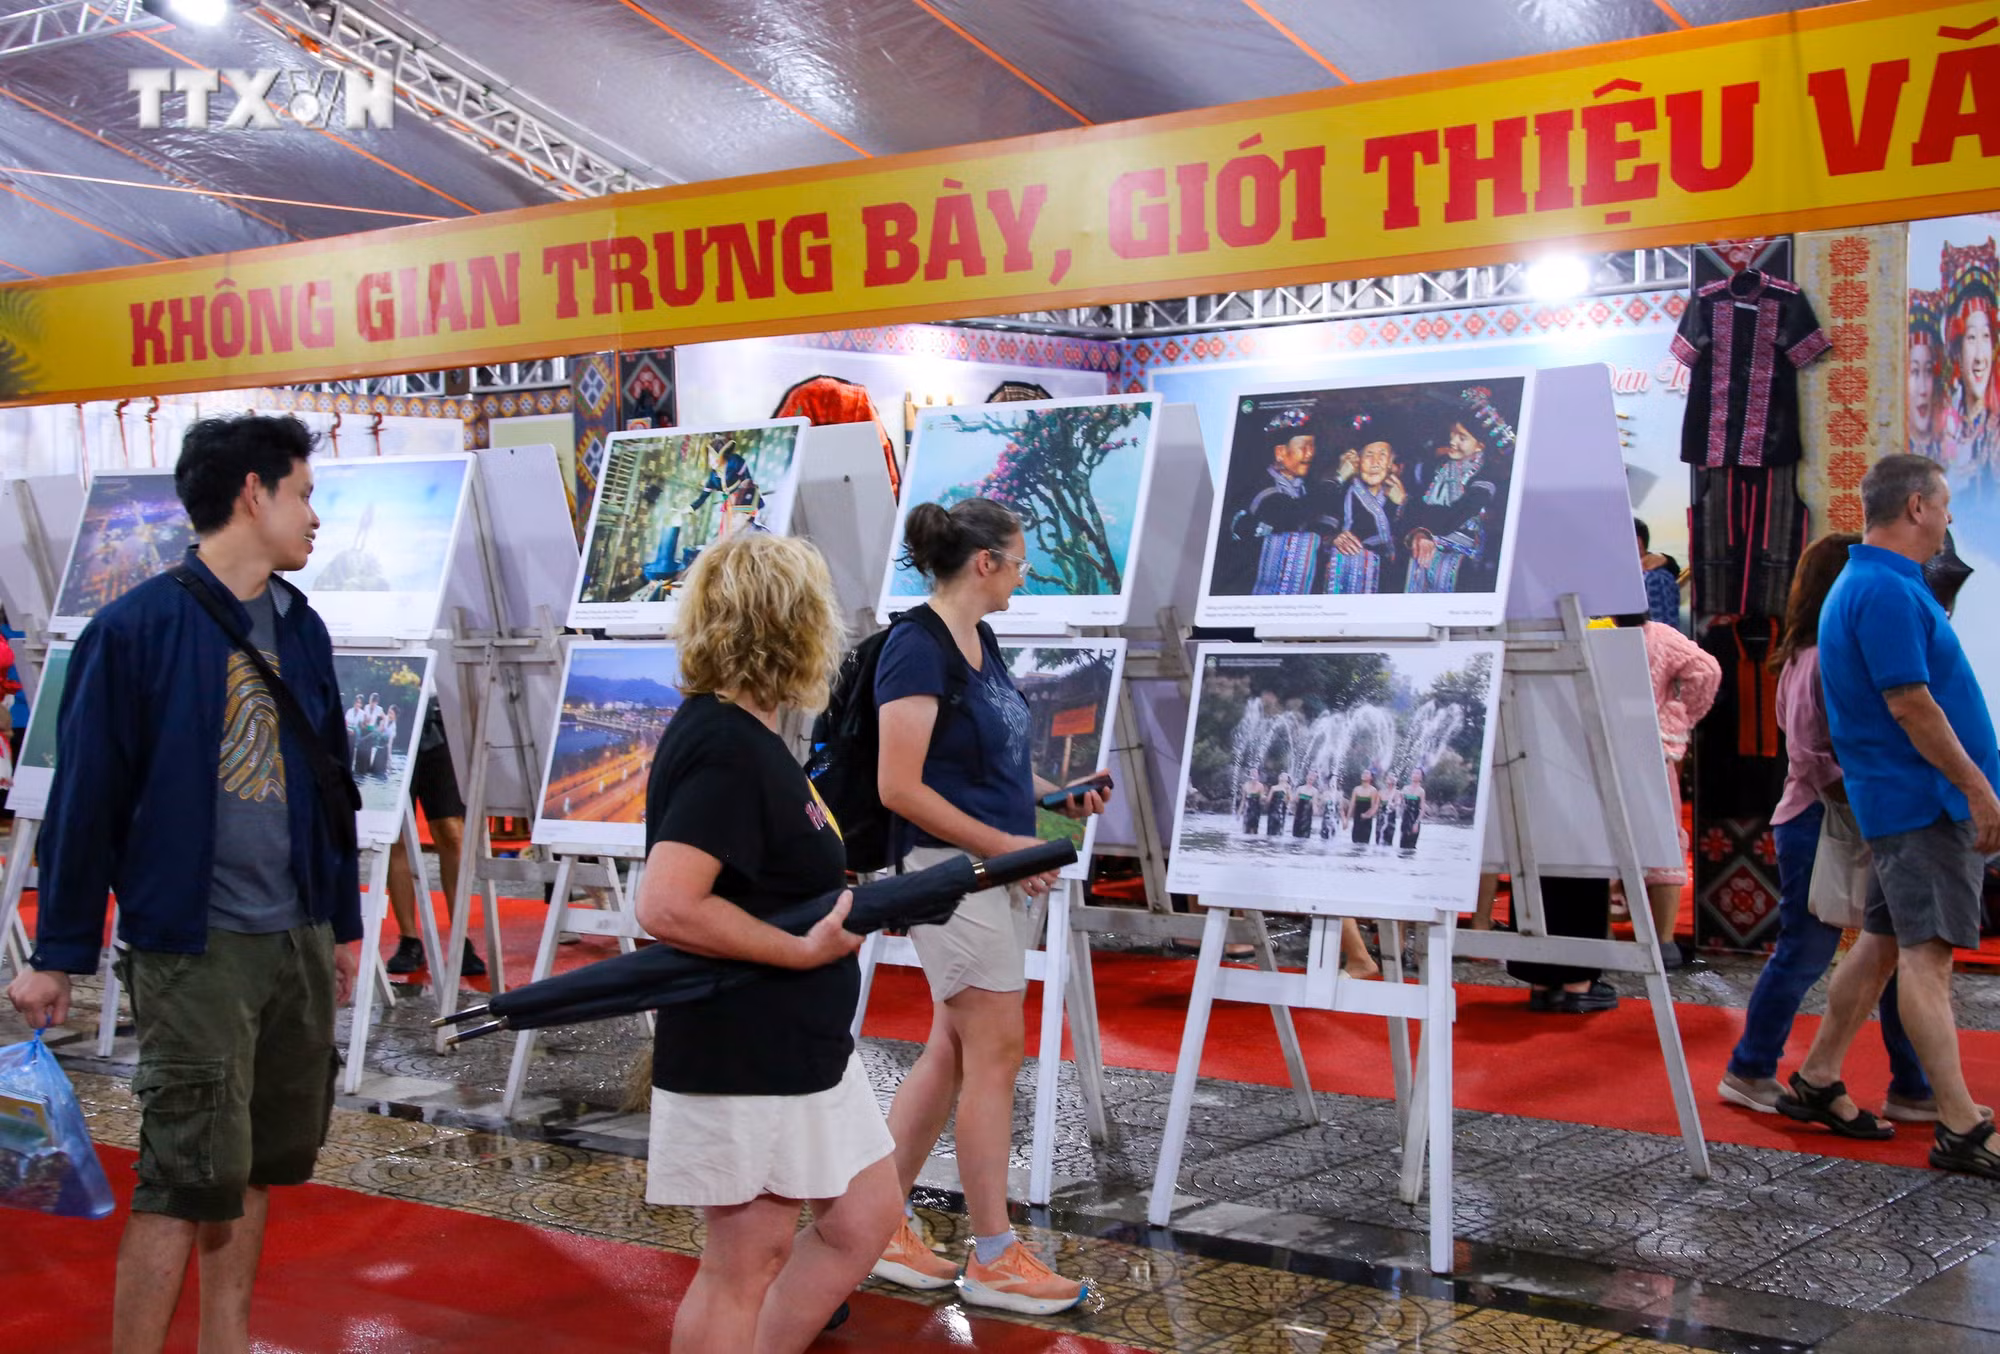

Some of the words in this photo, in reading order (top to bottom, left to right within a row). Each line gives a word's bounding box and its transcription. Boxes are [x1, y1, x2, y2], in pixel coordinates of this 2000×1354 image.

[130, 276, 335, 368] KHÔNG
[356, 252, 520, 343] GIAN
[543, 212, 833, 320] TRƯNG
[862, 177, 1072, 287] BÀY,
[1108, 133, 1326, 260] GIỚI
[1363, 78, 1760, 231] THIỆU
